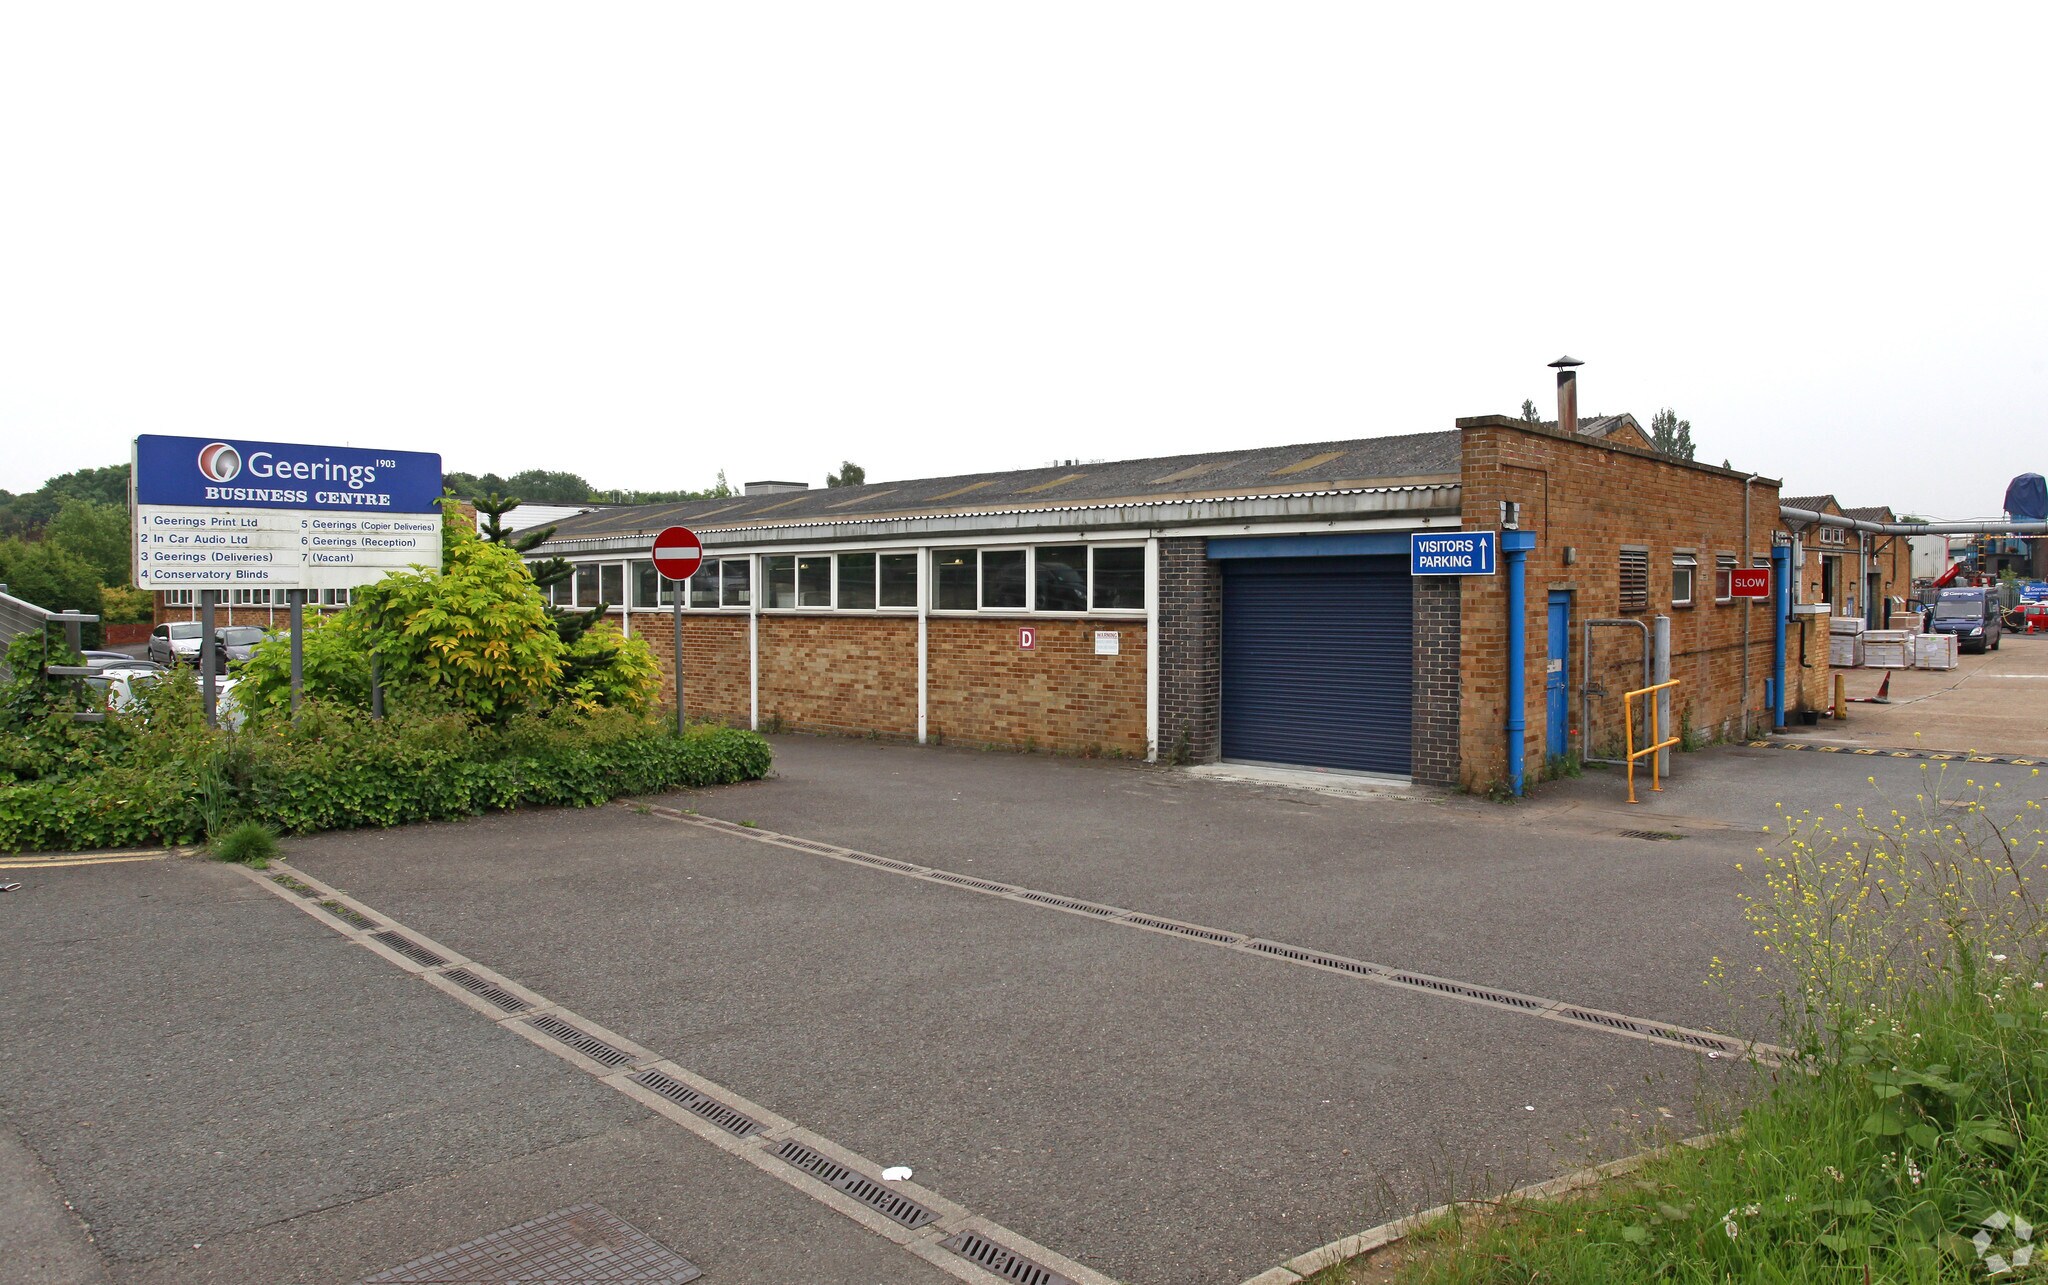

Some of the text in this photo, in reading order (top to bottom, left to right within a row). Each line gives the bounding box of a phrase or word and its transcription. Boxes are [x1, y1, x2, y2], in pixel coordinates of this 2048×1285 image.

[248, 452, 396, 489] Geerings 1903
[205, 486, 390, 506] BUSINESS CENTRE
[142, 515, 258, 528] 1 Geerings Print Ltd
[301, 519, 435, 532] 5 Geerings (Copier Deliveries)
[141, 533, 248, 544] 2 In Car Audio Ltd
[301, 536, 416, 548] 6 Geerings (Reception)
[1418, 540, 1473, 552] VISITORS
[141, 551, 273, 563] 3 Geerings (Deliveries)
[301, 553, 354, 562] 7 (Vacant)
[1419, 555, 1472, 568] PARKING
[141, 569, 269, 581] 4 Conservatory Blinds
[1734, 578, 1766, 588] SLOW
[1022, 631, 1032, 646] D
